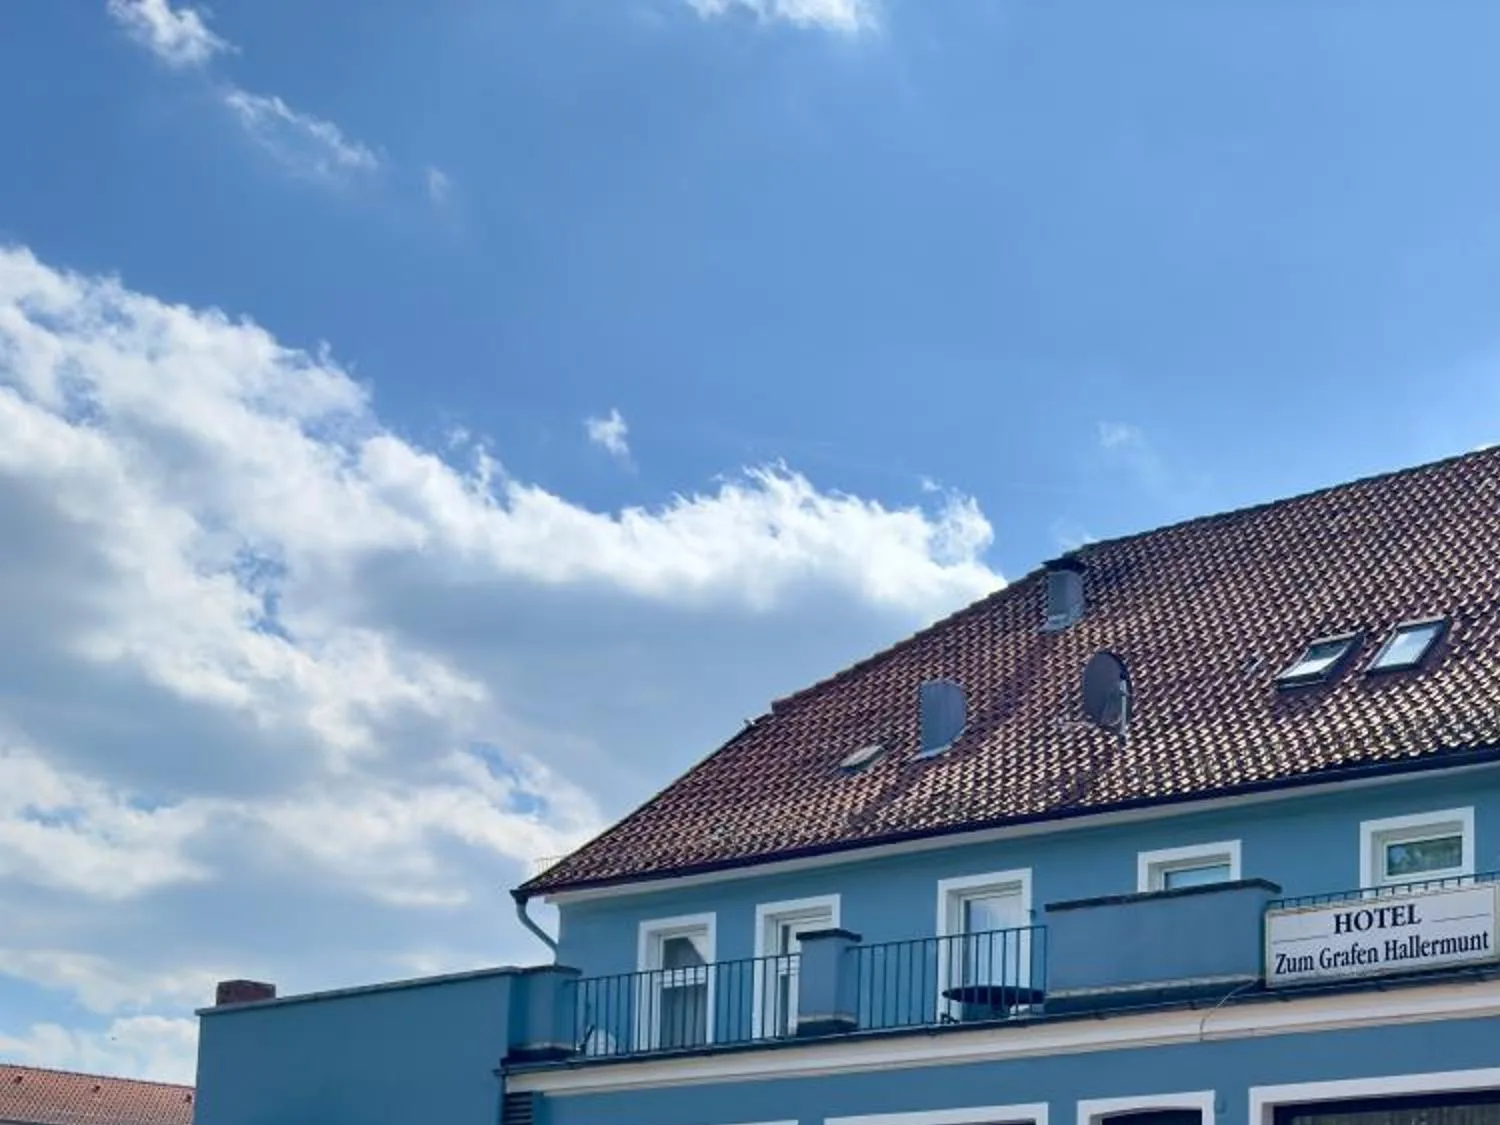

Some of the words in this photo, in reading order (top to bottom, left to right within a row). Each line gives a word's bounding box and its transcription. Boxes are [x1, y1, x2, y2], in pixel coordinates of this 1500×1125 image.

[1333, 903, 1423, 935] HOTEL
[1275, 952, 1315, 976] Zum
[1318, 942, 1380, 970] Grafen
[1384, 930, 1490, 962] Hallermunt
